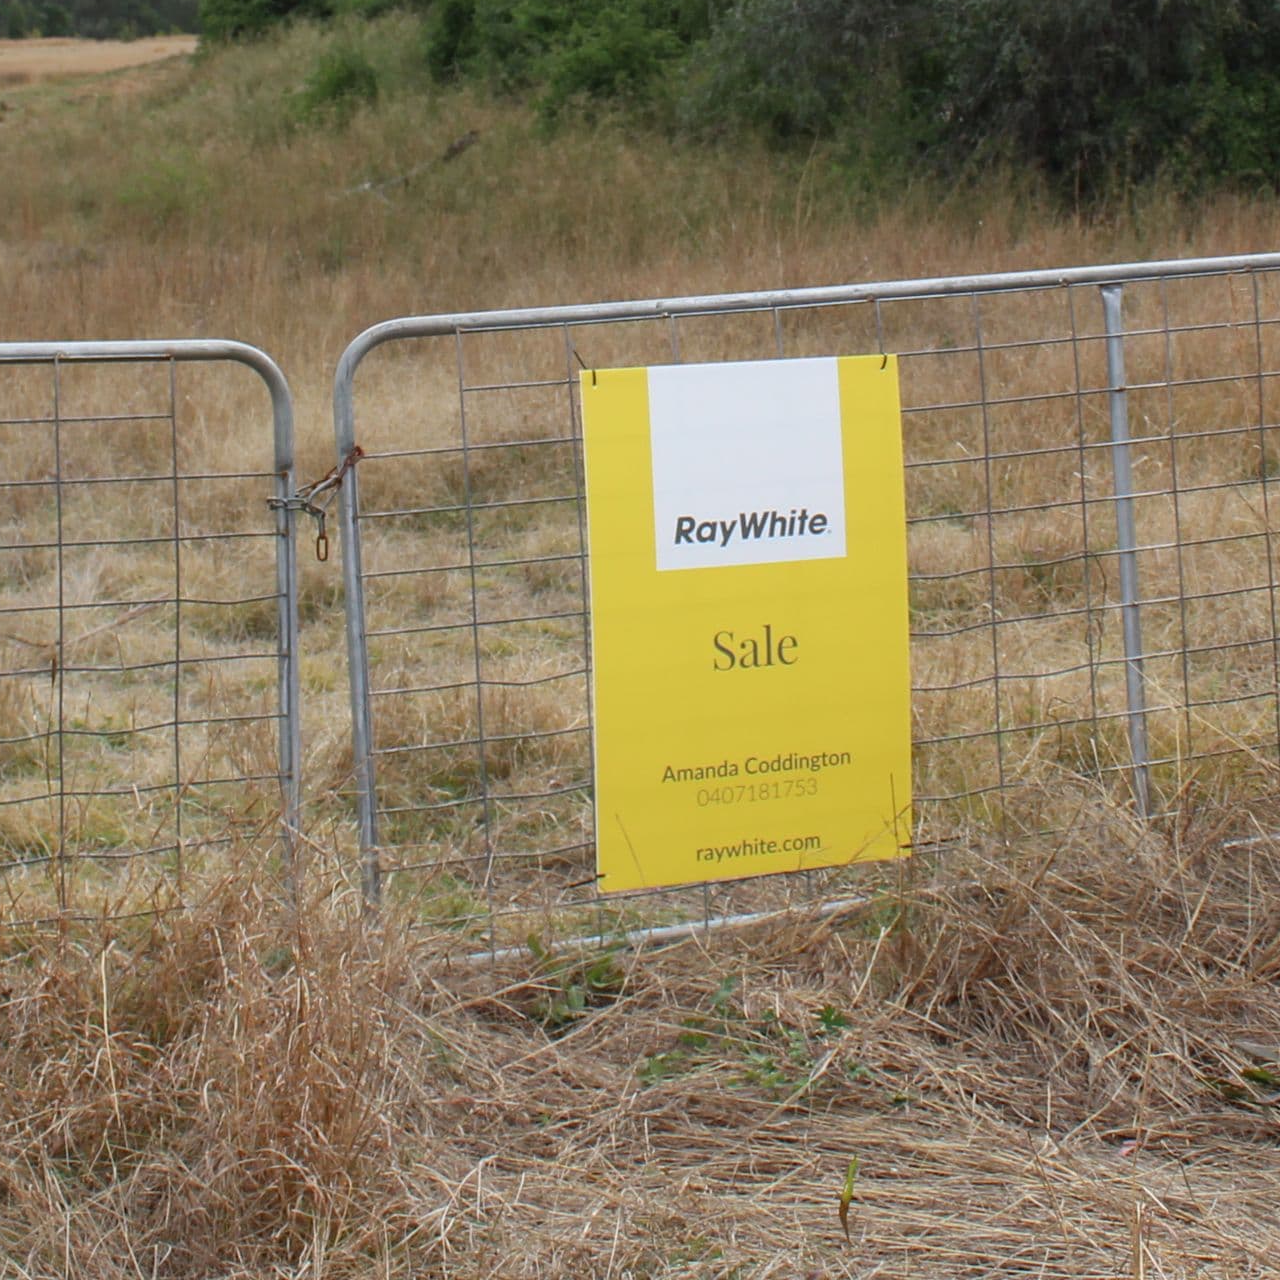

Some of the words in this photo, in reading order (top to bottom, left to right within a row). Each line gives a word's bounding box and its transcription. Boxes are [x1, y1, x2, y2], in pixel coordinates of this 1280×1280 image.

[713, 624, 800, 672] Sale
[661, 760, 739, 784] Amanda
[744, 751, 852, 776] Coddington
[696, 777, 818, 807] 0407181753
[696, 835, 821, 863] raywhite.com
